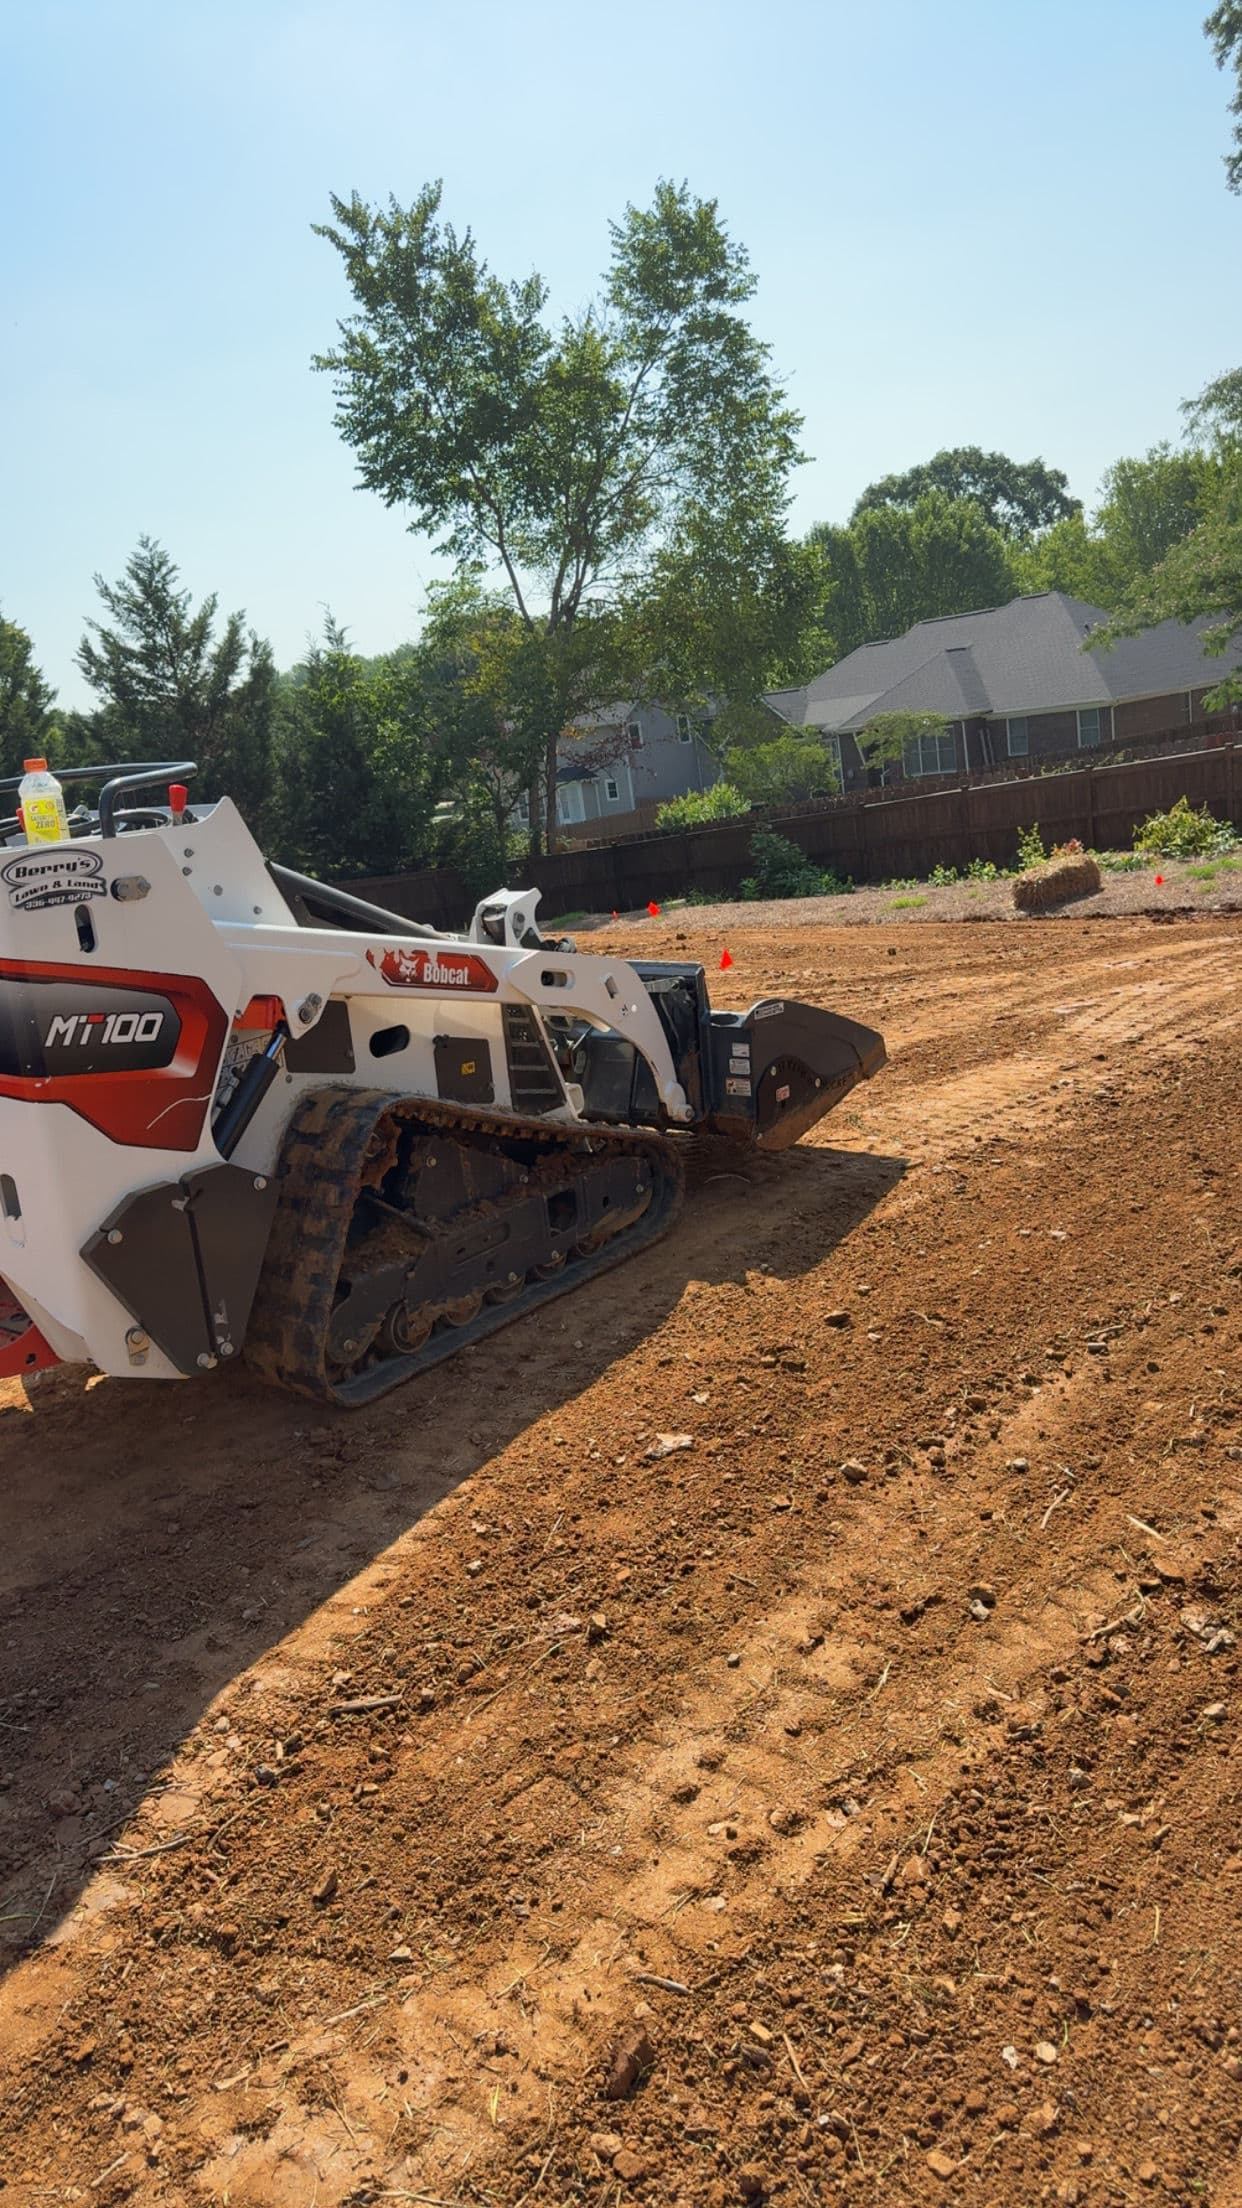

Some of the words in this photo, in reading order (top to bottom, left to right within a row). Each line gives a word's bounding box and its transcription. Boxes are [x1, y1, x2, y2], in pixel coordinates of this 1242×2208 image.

[15, 857, 92, 879] Berry's
[15, 884, 48, 903] Lawn
[52, 880, 62, 889] &
[67, 879, 98, 889] Land
[423, 962, 469, 985] Bobcat
[44, 1012, 164, 1047] MT100
